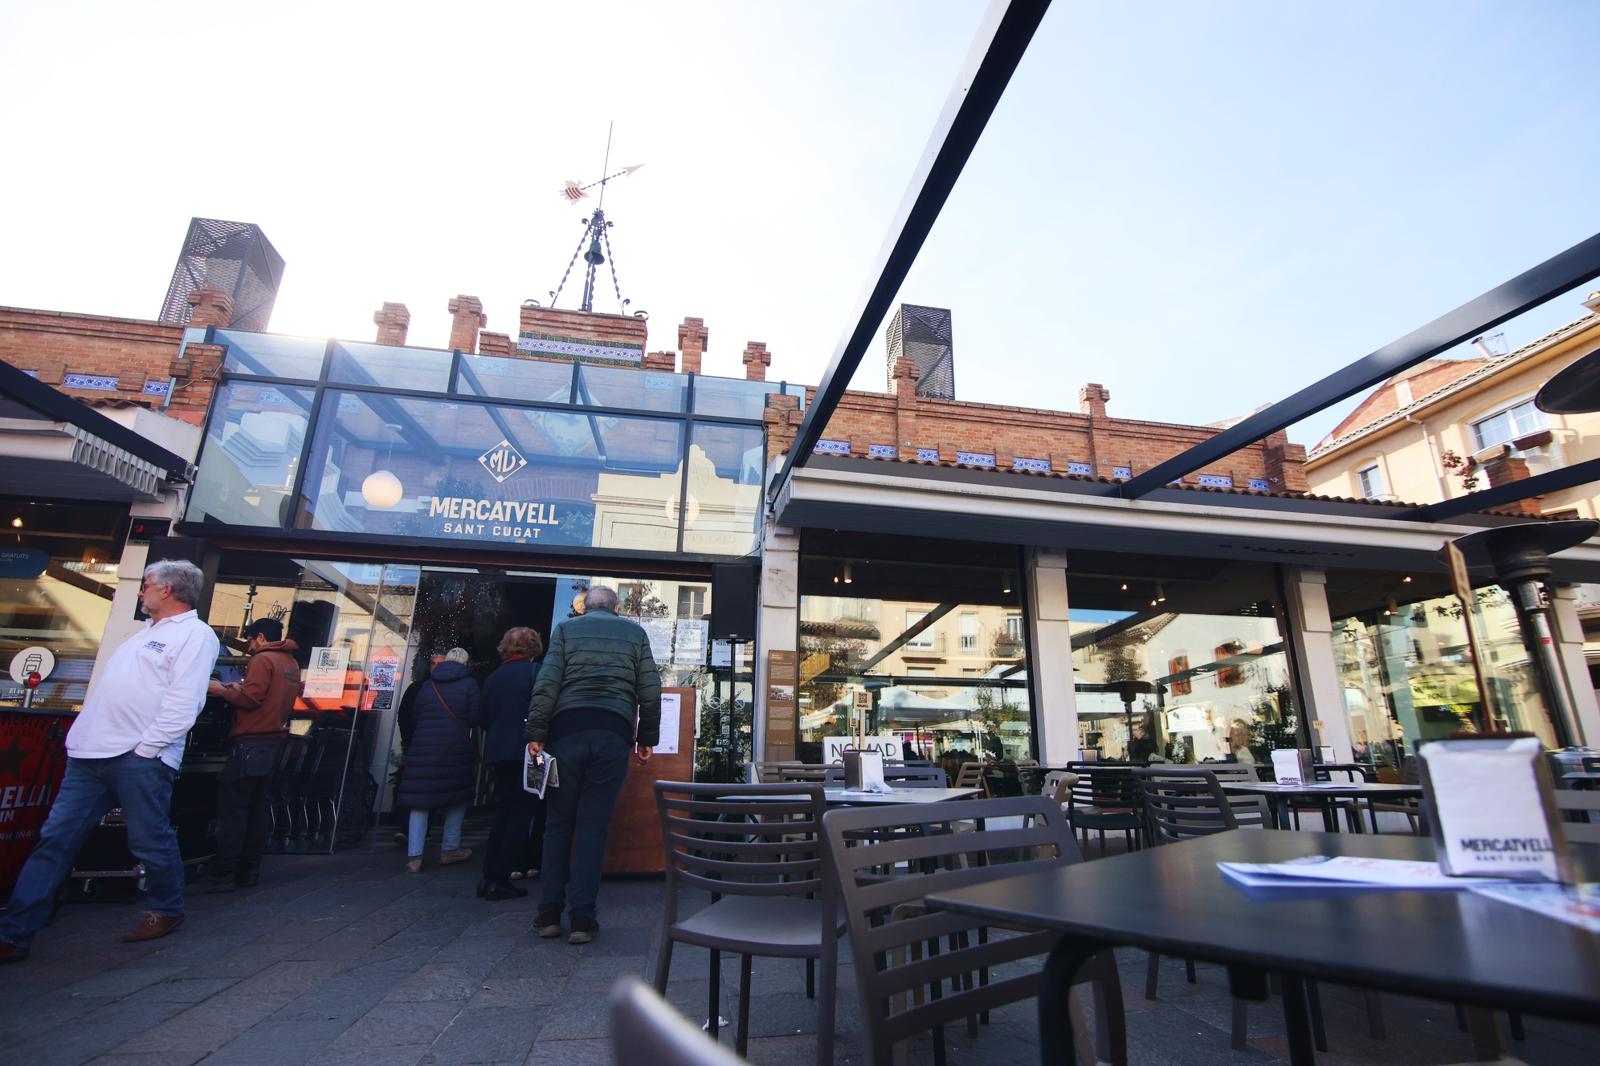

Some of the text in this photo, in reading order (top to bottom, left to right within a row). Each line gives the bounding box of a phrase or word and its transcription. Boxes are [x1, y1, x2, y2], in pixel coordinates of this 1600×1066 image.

[429, 496, 560, 525] MERCATVELL
[443, 522, 541, 538] SANT CUGAT
